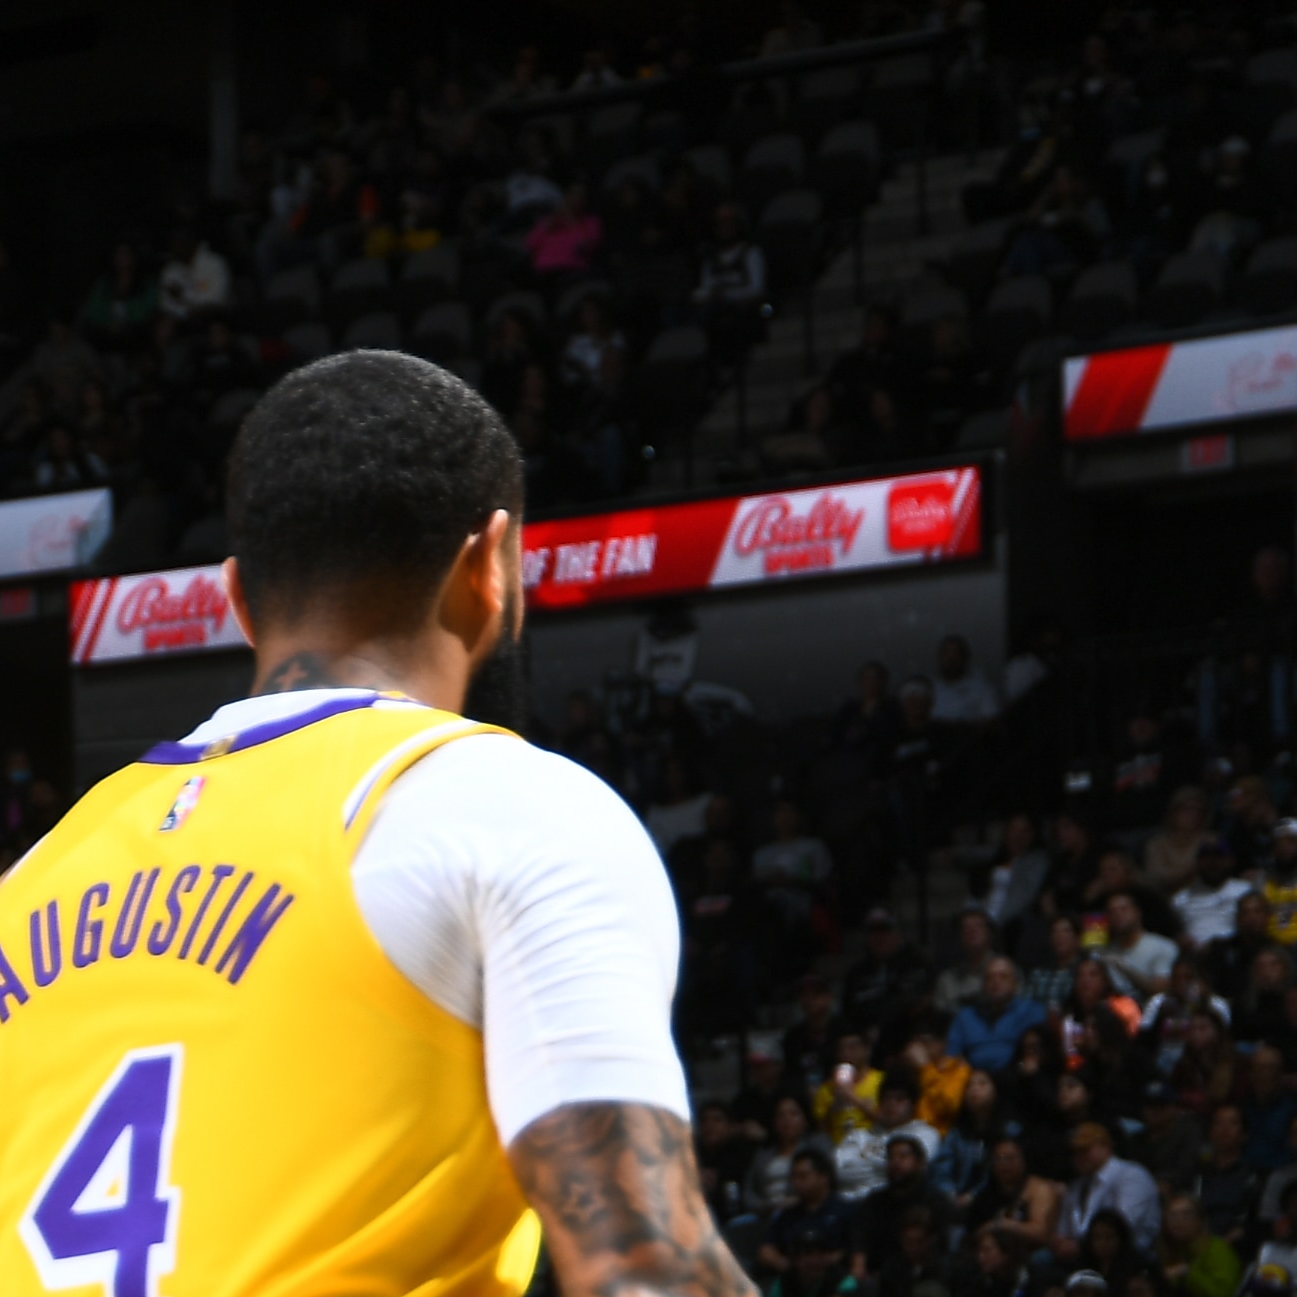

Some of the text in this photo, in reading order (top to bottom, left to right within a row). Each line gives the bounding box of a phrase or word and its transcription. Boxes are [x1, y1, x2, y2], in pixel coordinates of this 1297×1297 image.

[736, 492, 864, 556] Bally
[554, 541, 599, 583] THE
[604, 532, 657, 576] FAN
